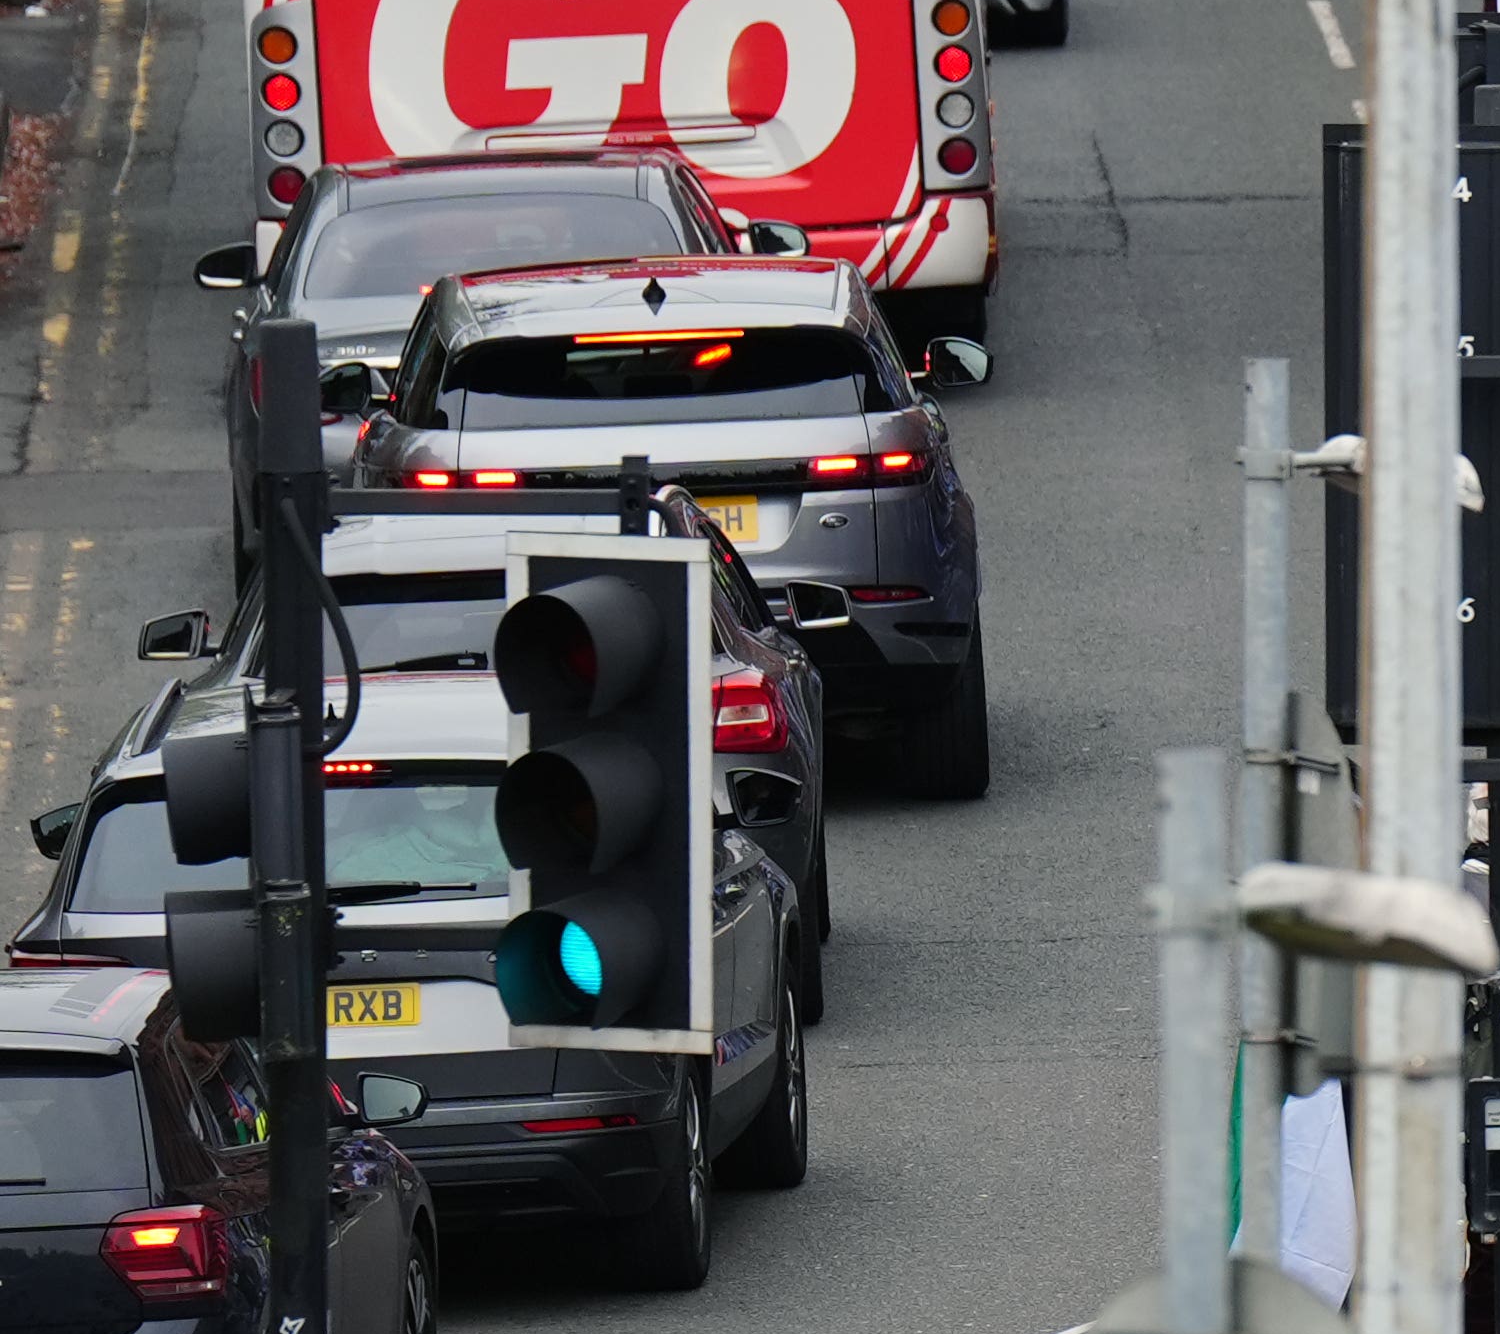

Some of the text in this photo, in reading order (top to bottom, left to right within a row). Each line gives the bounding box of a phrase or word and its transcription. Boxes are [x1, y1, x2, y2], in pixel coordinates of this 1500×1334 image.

[1451, 180, 1472, 203] 4
[1455, 597, 1476, 622] 6
[333, 990, 402, 1023] RXB
